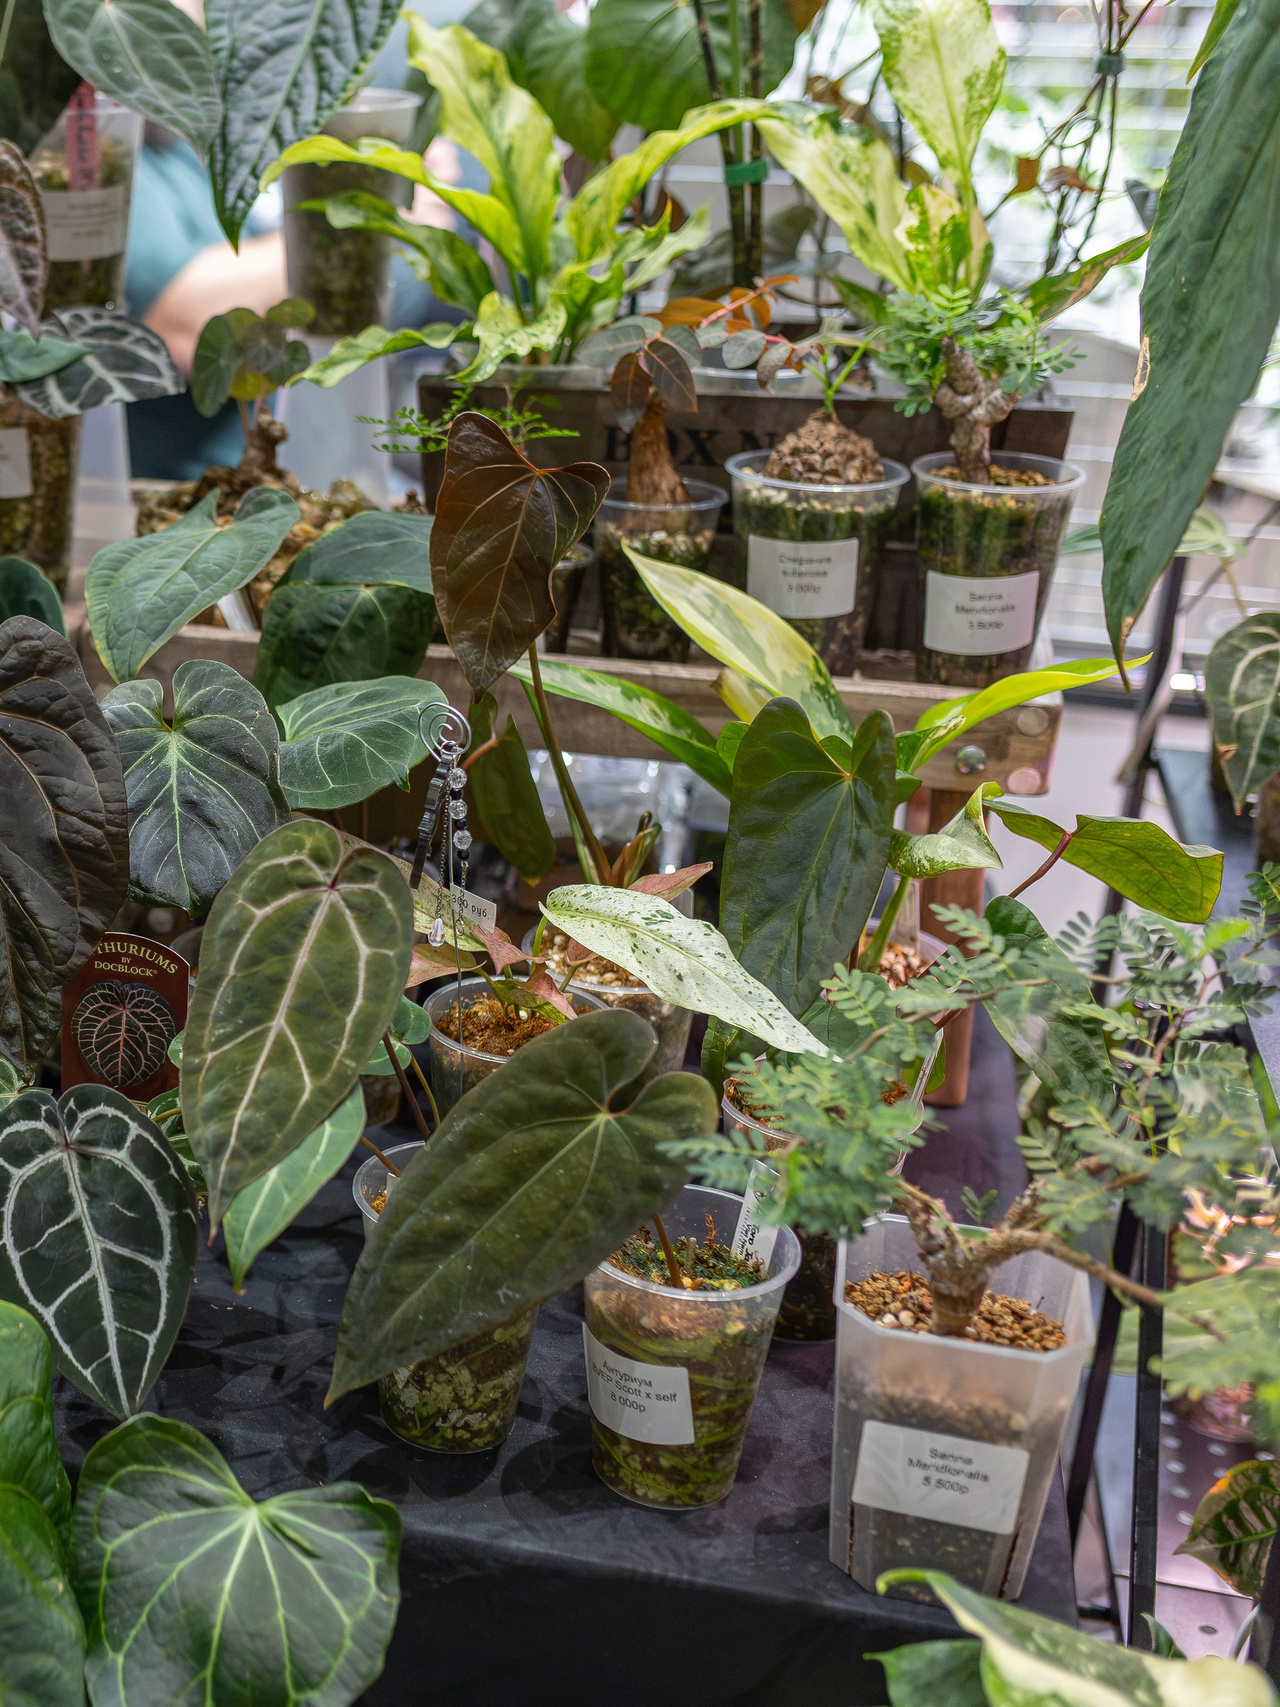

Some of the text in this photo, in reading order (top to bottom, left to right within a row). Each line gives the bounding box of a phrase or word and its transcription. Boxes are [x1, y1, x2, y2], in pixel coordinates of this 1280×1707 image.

[96, 941, 179, 974] THURIUMS
[602, 1360, 653, 1388] Антуриум
[615, 1380, 642, 1398] Scott
[655, 1392, 677, 1403] self
[929, 1447, 974, 1466] Senna
